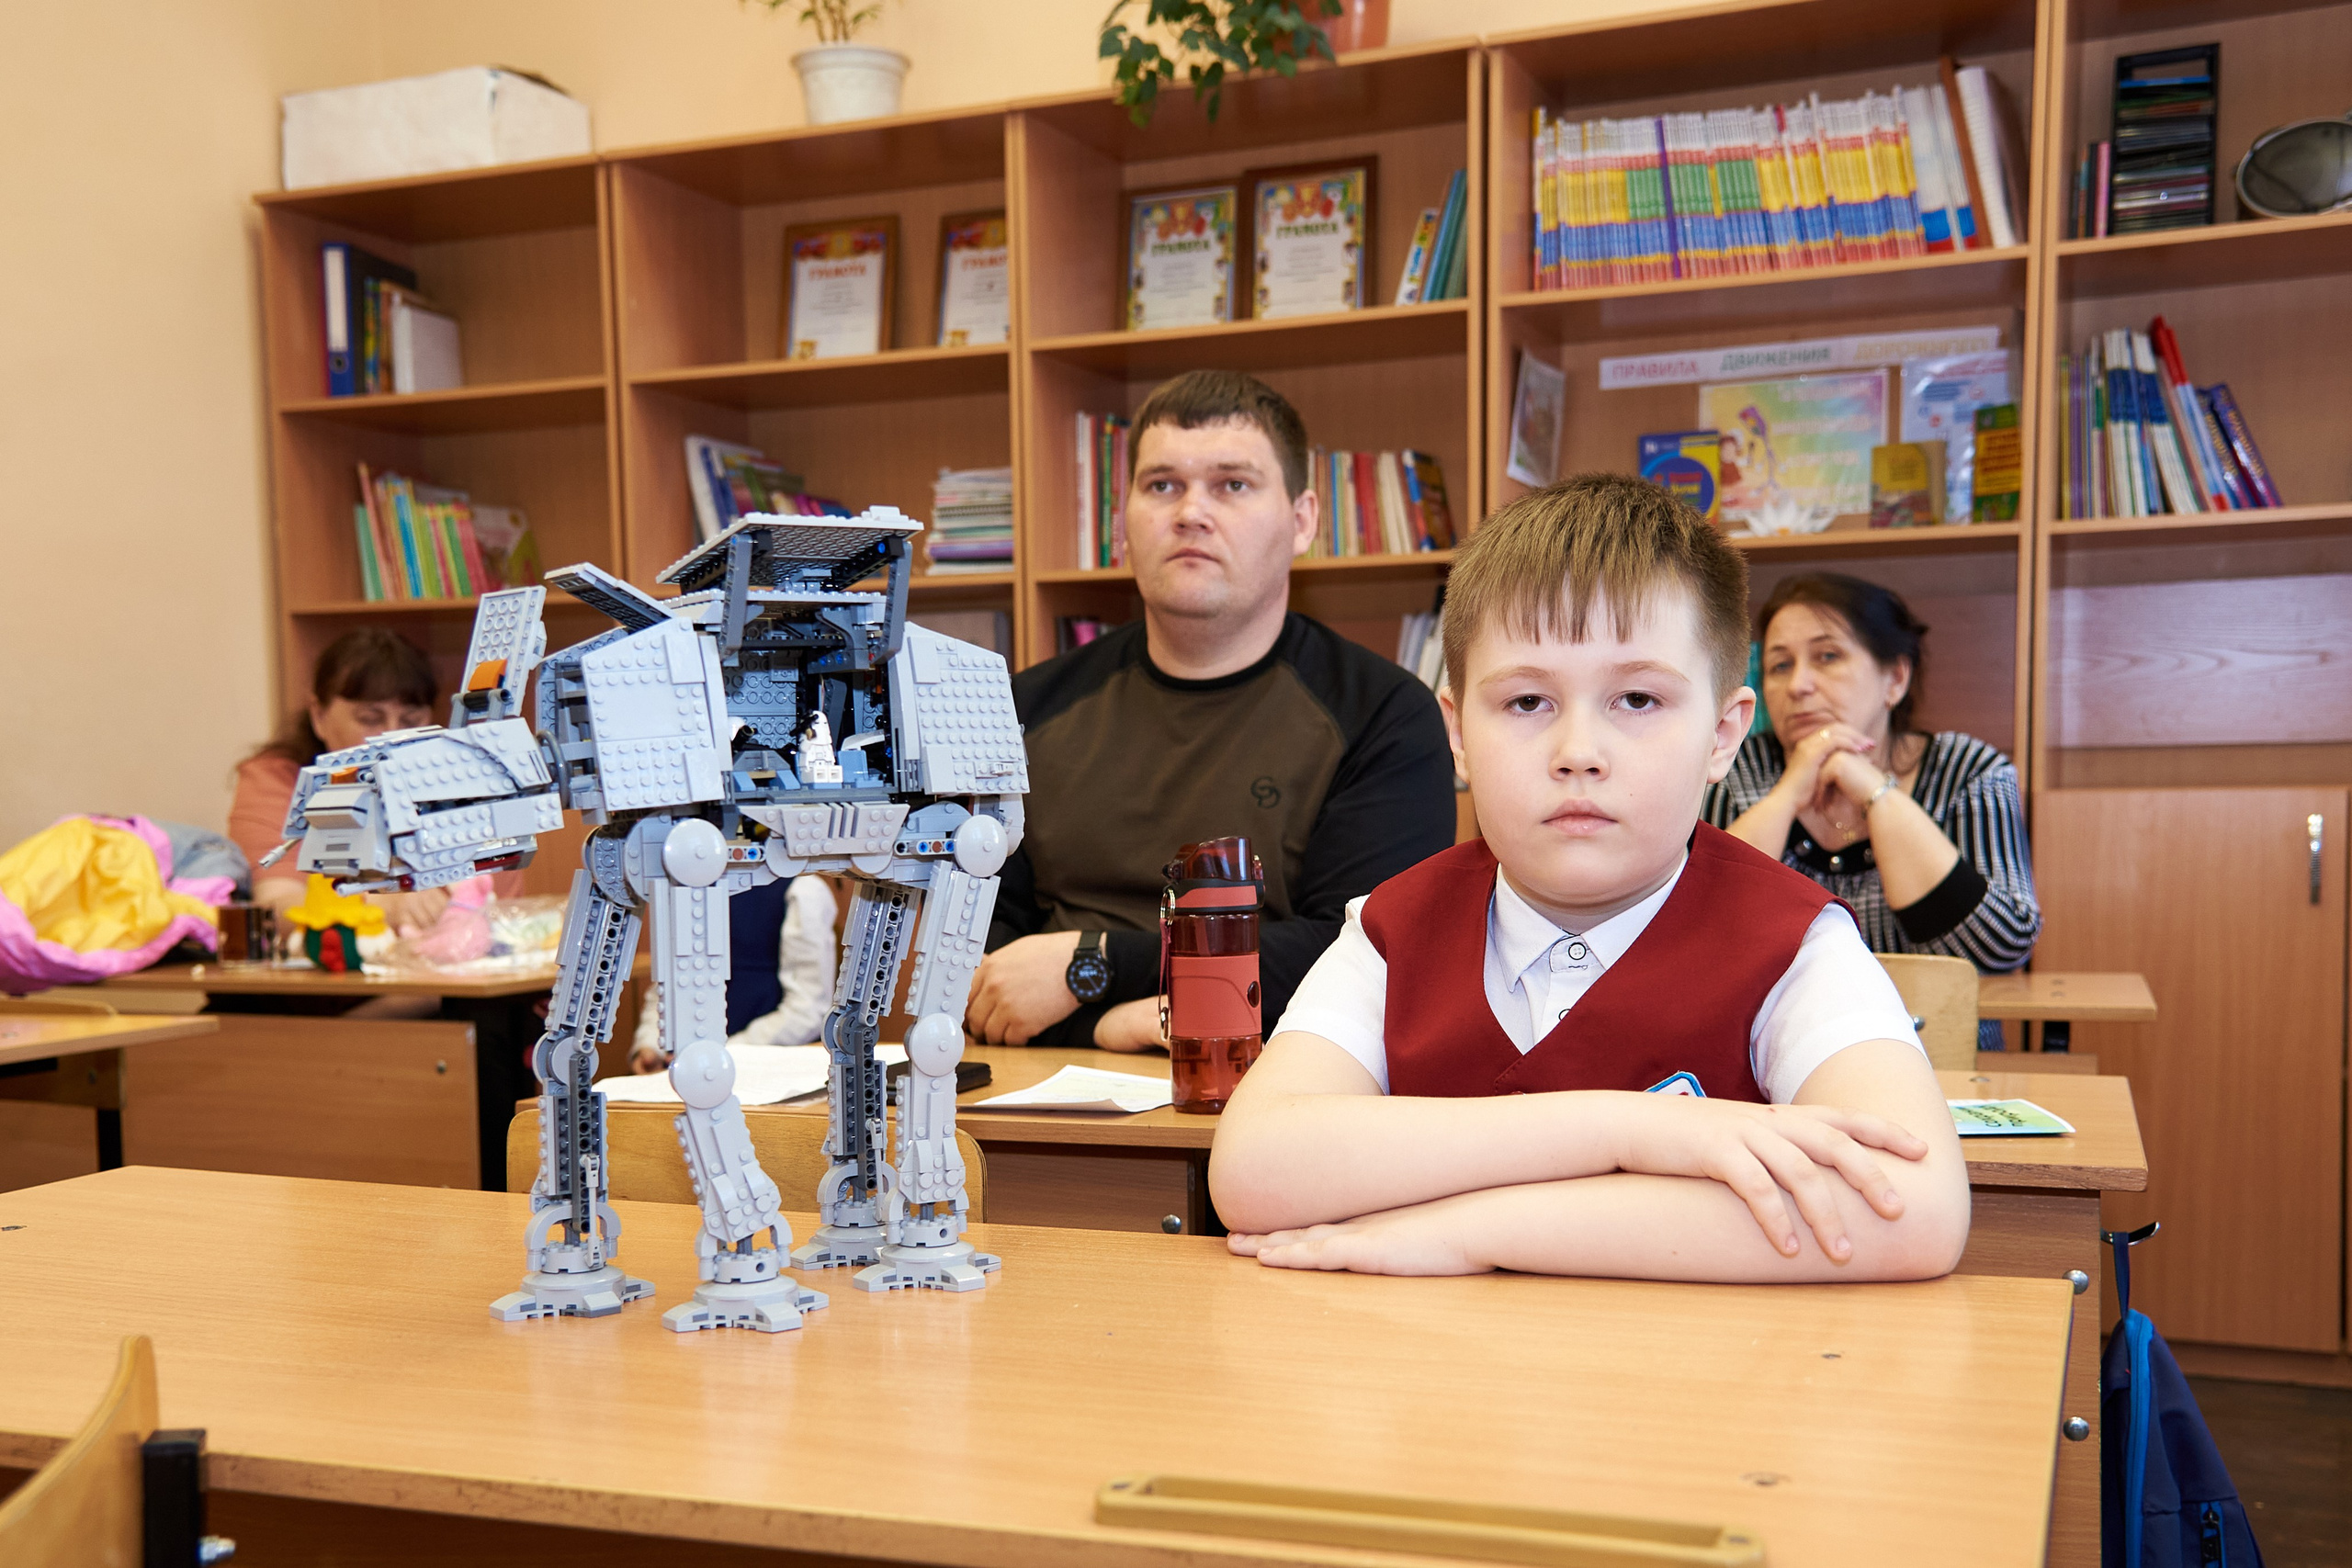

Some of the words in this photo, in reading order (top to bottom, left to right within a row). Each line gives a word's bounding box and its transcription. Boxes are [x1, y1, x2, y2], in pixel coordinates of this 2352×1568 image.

[1276, 221, 1340, 240] ГРАМОТА
[1151, 240, 1211, 257] ГРАМОТА
[961, 255, 1007, 272] ГРАМО
[808, 264, 865, 281] ГРАМОТА
[1612, 360, 1698, 379] ПРАВИЛА
[1720, 347, 1830, 371] ДВИЖЕНИЯ
